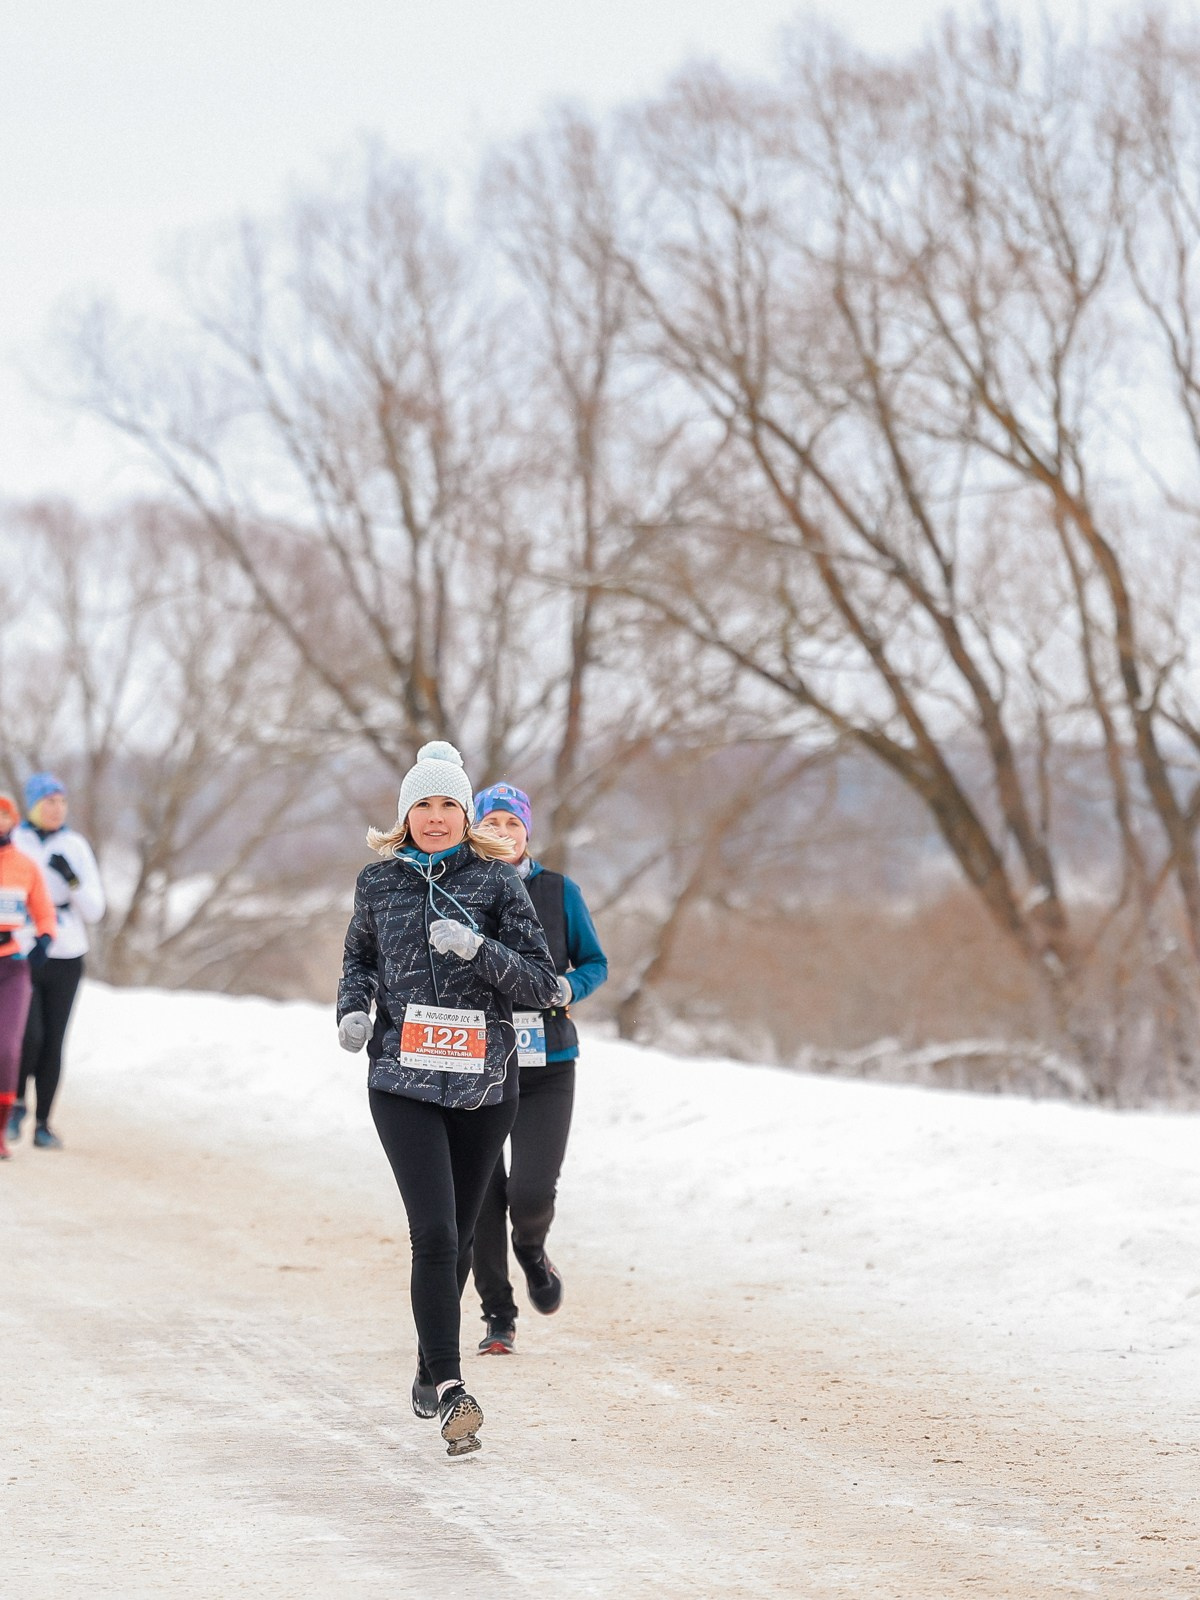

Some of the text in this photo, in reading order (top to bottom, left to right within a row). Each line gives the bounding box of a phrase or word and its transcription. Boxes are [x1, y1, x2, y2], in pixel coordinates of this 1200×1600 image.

[426, 1012, 459, 1022] NOVGOROD
[460, 1015, 471, 1024] ICE
[422, 1027, 469, 1050] 122
[517, 1030, 531, 1048] 0
[416, 1047, 473, 1058] ХАРЧЕНКО ТАТЬЯНА
